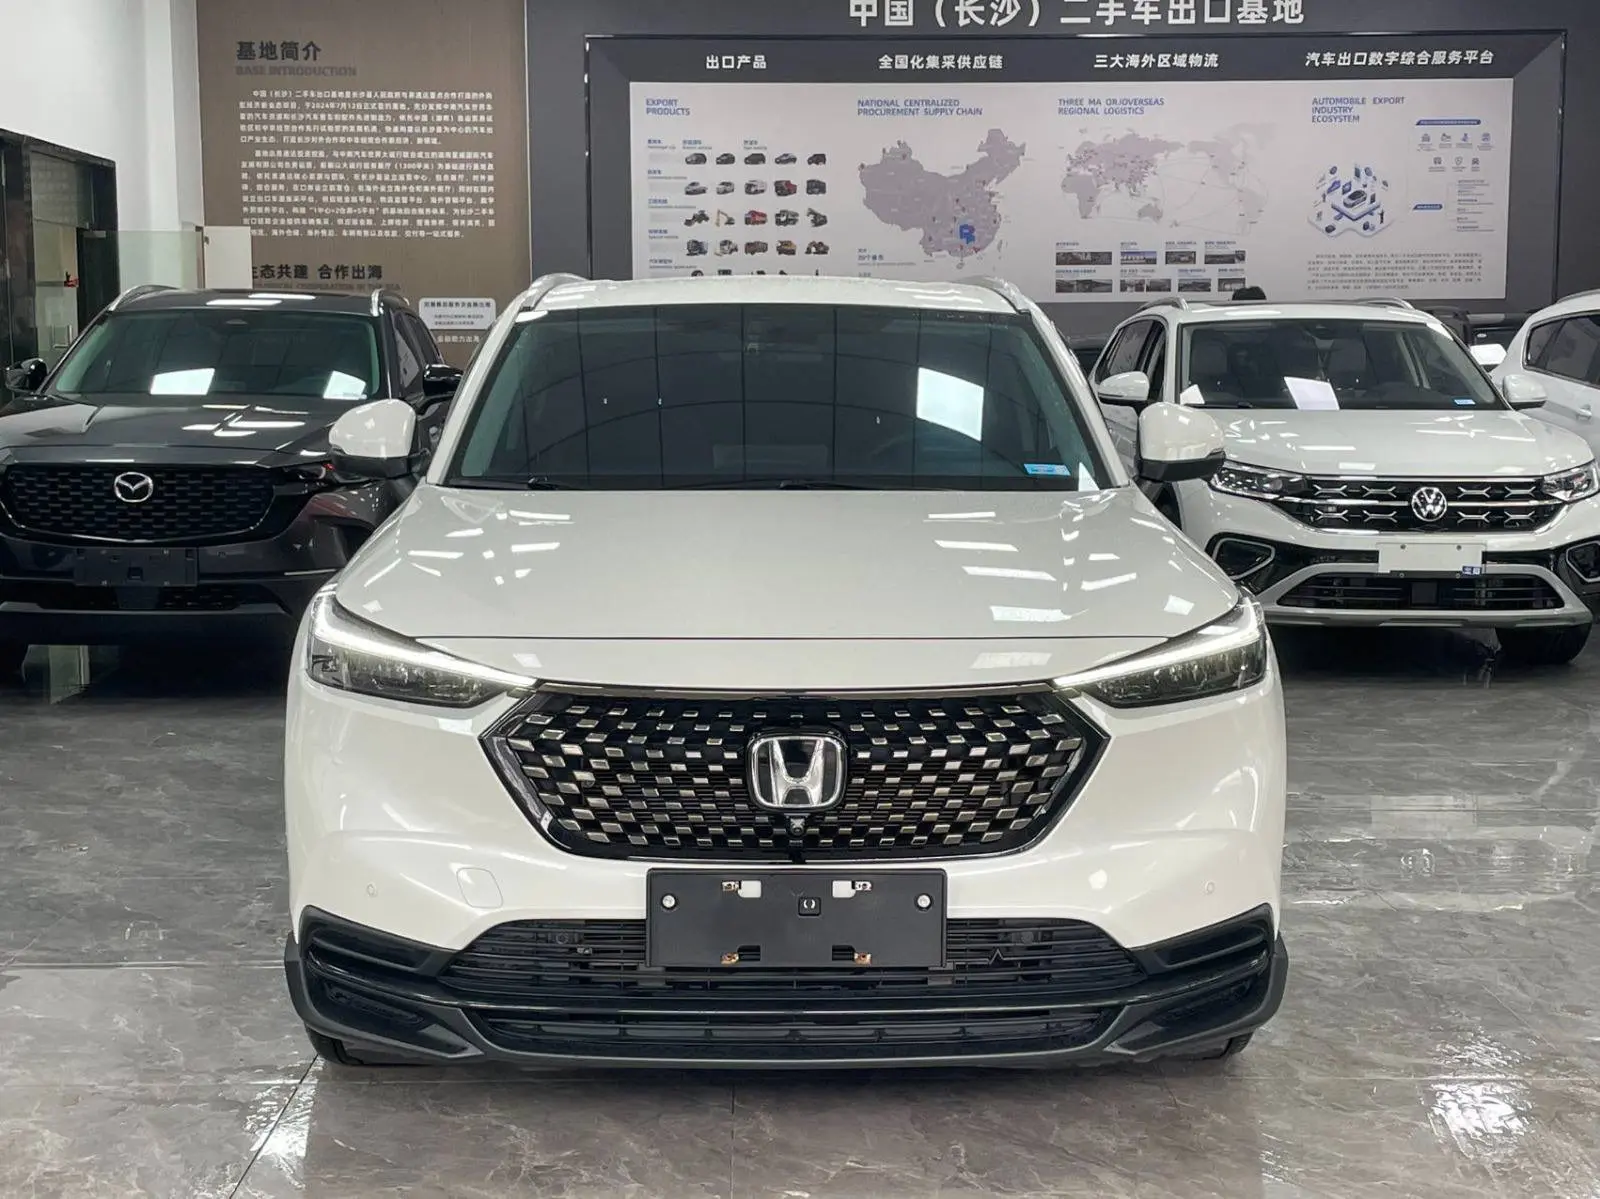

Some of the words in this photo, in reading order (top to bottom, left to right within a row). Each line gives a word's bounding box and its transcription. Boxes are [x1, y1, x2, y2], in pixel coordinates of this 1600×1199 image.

[236, 40, 322, 61] 基地简介
[706, 55, 767, 69] 出口产品
[878, 54, 1004, 70] 全国化集采供应链
[1093, 53, 1219, 69] 三大海外区域物流
[1304, 50, 1495, 67] 汽车出口数字综合服务平台
[645, 98, 679, 107] EXPORT
[857, 99, 900, 107] NATIONAL
[903, 99, 960, 107] CENTRALIZED
[1058, 98, 1084, 106] THREE
[1311, 97, 1367, 105] AUTOMOBILE
[1372, 96, 1406, 105] EXPORT
[645, 107, 691, 116] PRODUCTS
[857, 108, 920, 116] PROCUREMENT
[923, 108, 954, 116] SUPPLY
[956, 107, 983, 116] CHAIN
[1058, 107, 1100, 115] REGIONAL
[1103, 107, 1145, 115] LOGISTICS
[1311, 106, 1354, 114] INDUSTRY
[1311, 115, 1361, 123] ECOSYSTEM
[317, 264, 383, 279] 合作出海
